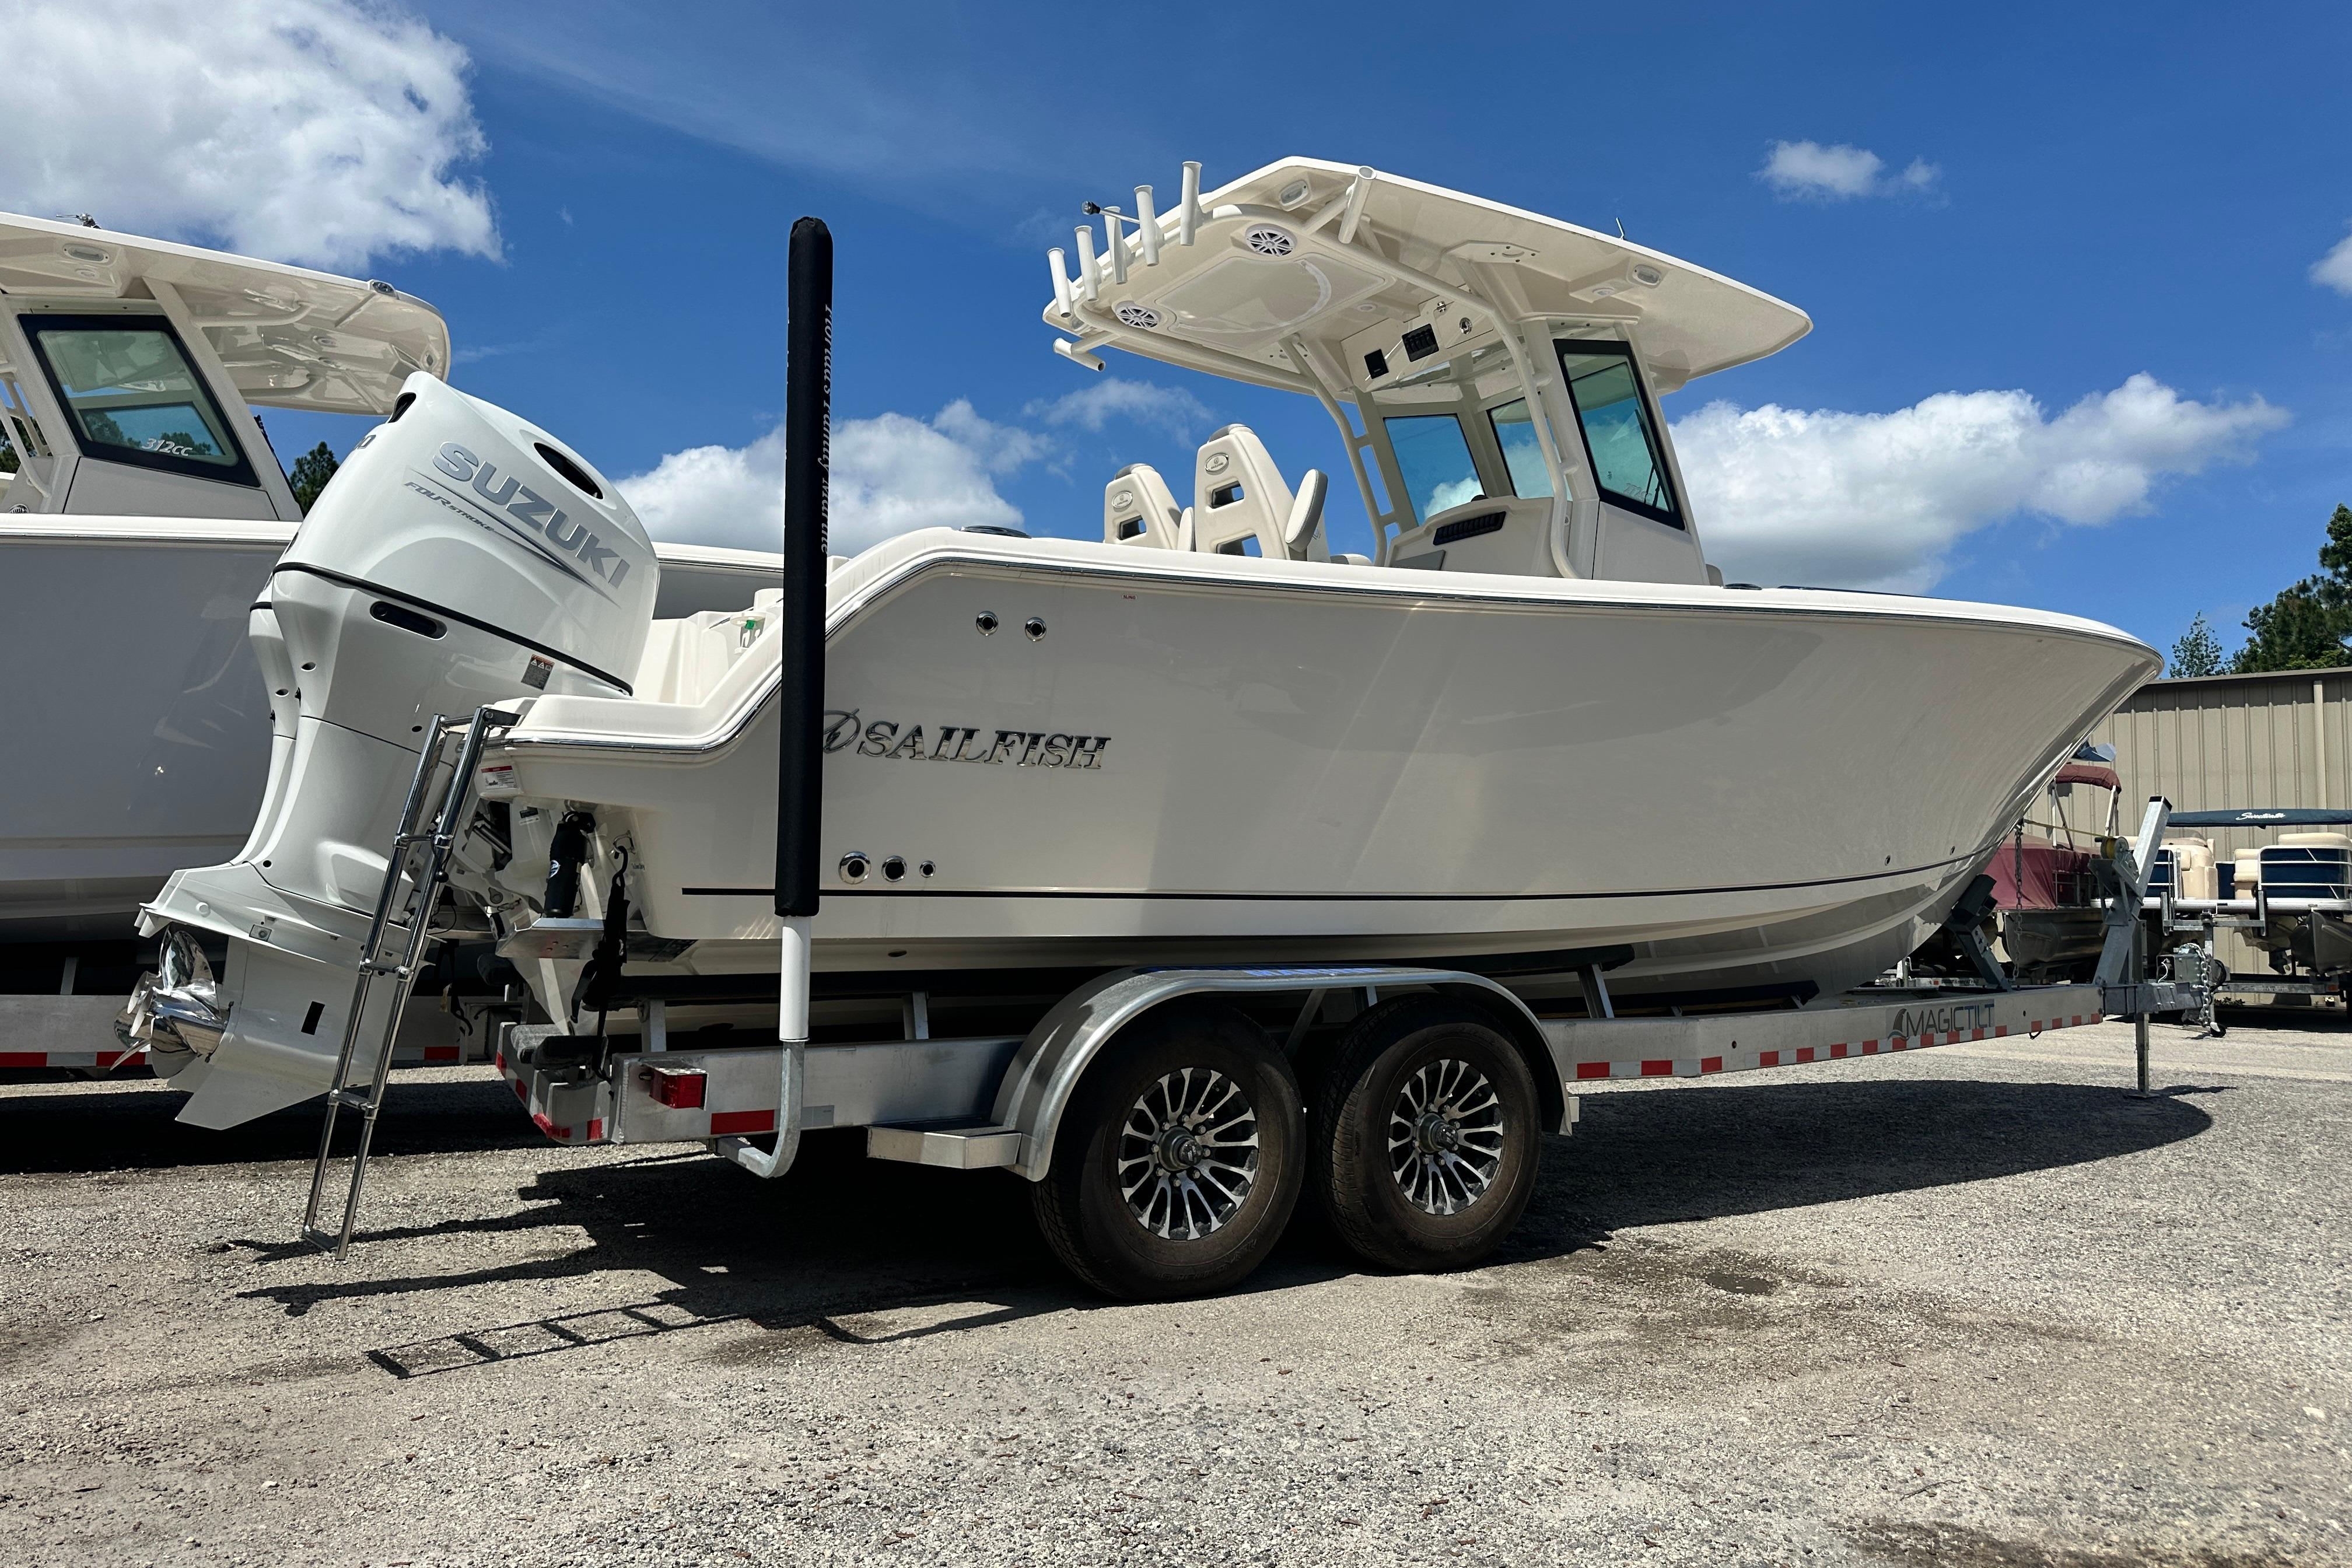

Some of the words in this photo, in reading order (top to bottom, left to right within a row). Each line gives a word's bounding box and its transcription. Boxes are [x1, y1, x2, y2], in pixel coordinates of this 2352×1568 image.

[404, 482, 452, 506] FOUR
[449, 505, 495, 531] STROKE
[432, 442, 630, 589] SUZUKI
[857, 720, 1112, 769] SAILFISH
